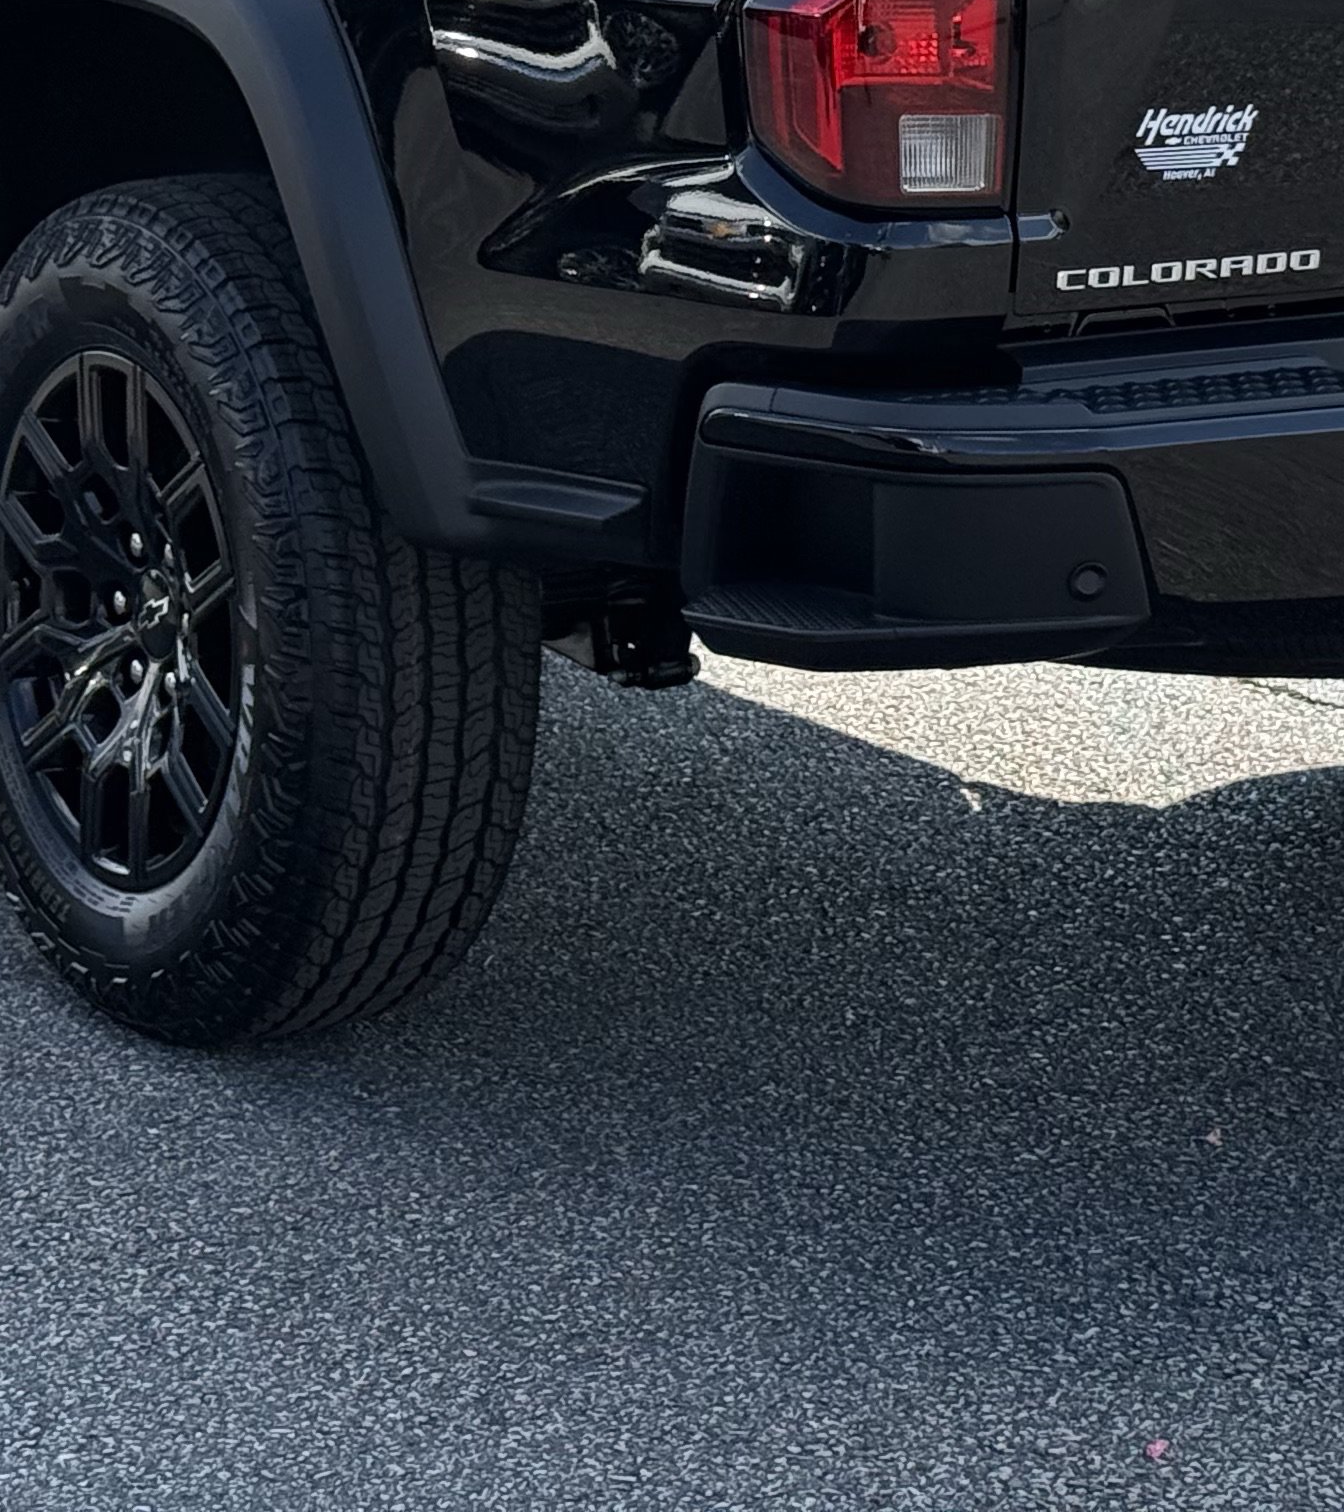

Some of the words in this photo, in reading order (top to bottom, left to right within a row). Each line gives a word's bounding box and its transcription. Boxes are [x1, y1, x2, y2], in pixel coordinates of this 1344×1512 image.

[1136, 104, 1259, 146] Hendrick
[1183, 132, 1250, 145] CHEVROLET
[1056, 249, 1321, 291] COLORADO
